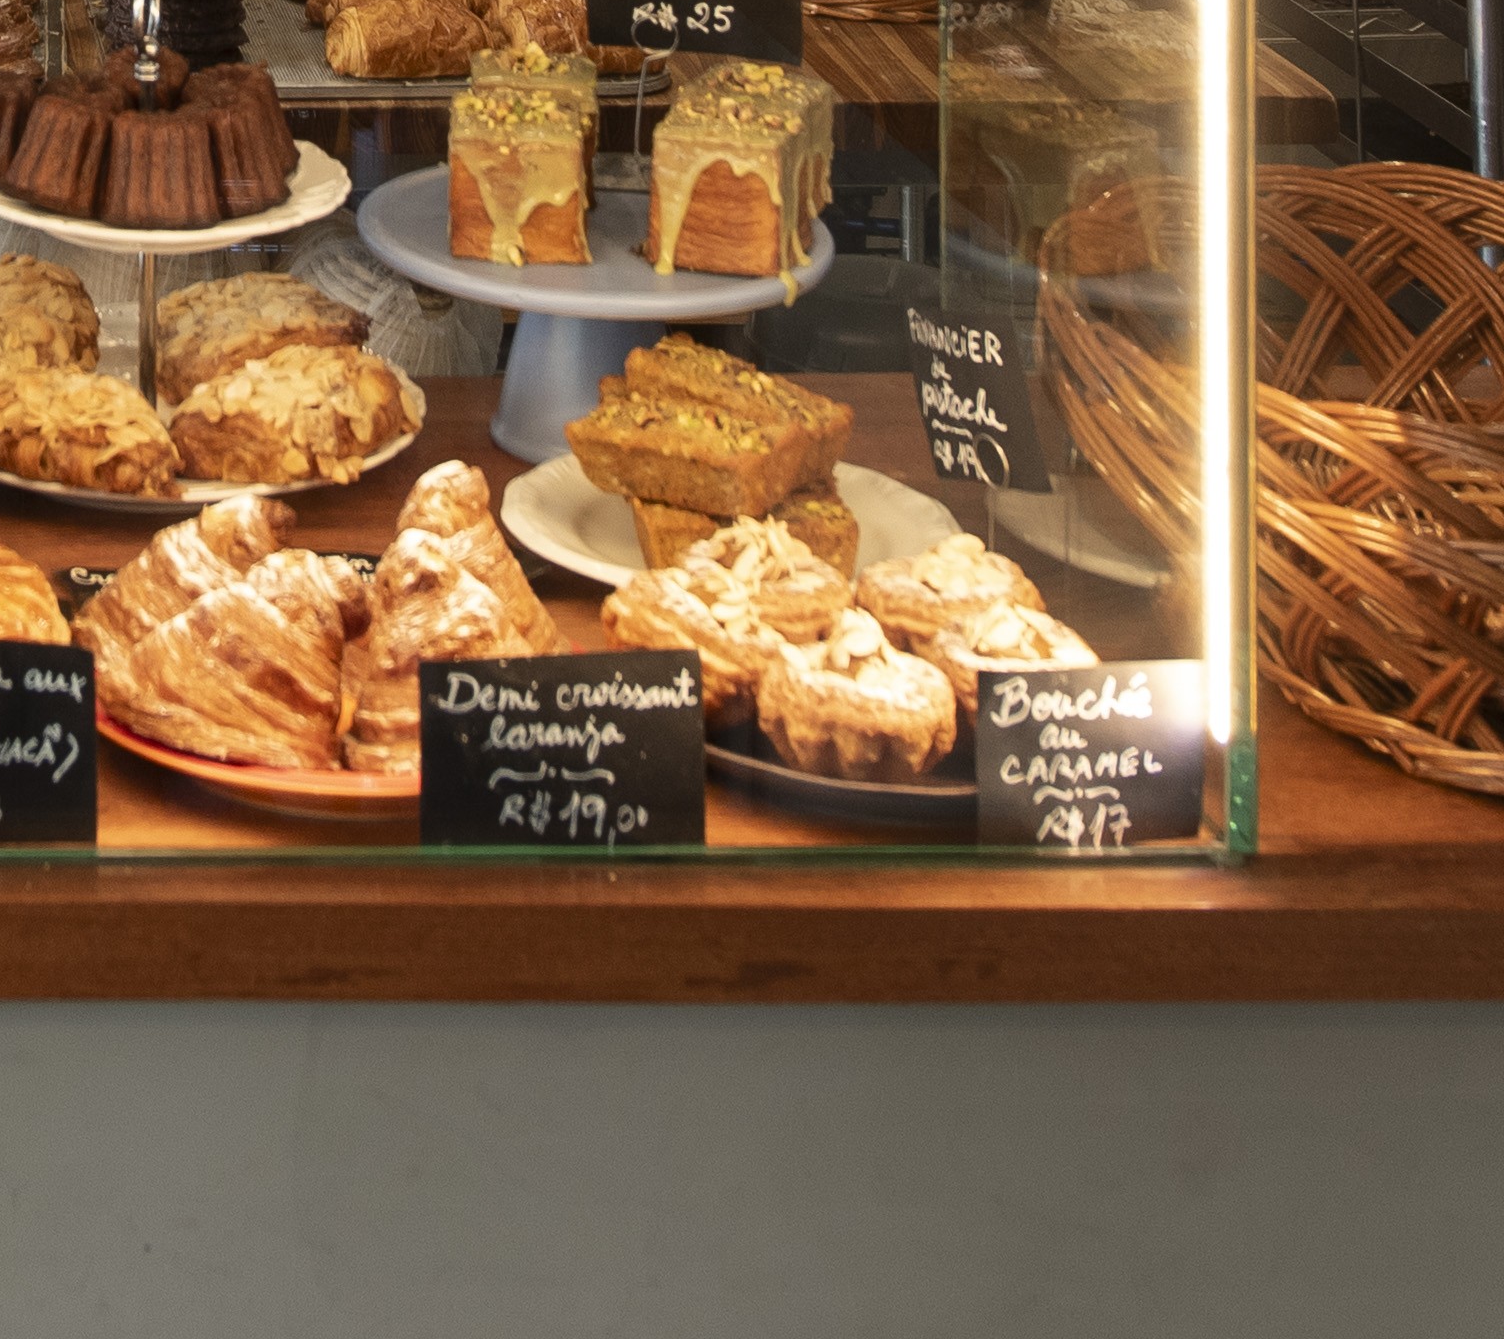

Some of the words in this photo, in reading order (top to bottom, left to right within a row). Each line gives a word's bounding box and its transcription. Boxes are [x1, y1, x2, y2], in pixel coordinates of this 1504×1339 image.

[632, 2, 677, 29] R$
[686, 4, 735, 34] 25
[23, 667, 87, 703] aux
[437, 671, 541, 713] Demi
[555, 667, 698, 711] croissant
[481, 713, 626, 764] laranja
[1039, 723, 1088, 750] au
[999, 746, 1163, 785] CARAMEL
[498, 790, 552, 835] R$
[1036, 805, 1085, 855] R$
[1089, 802, 1132, 851] 17
